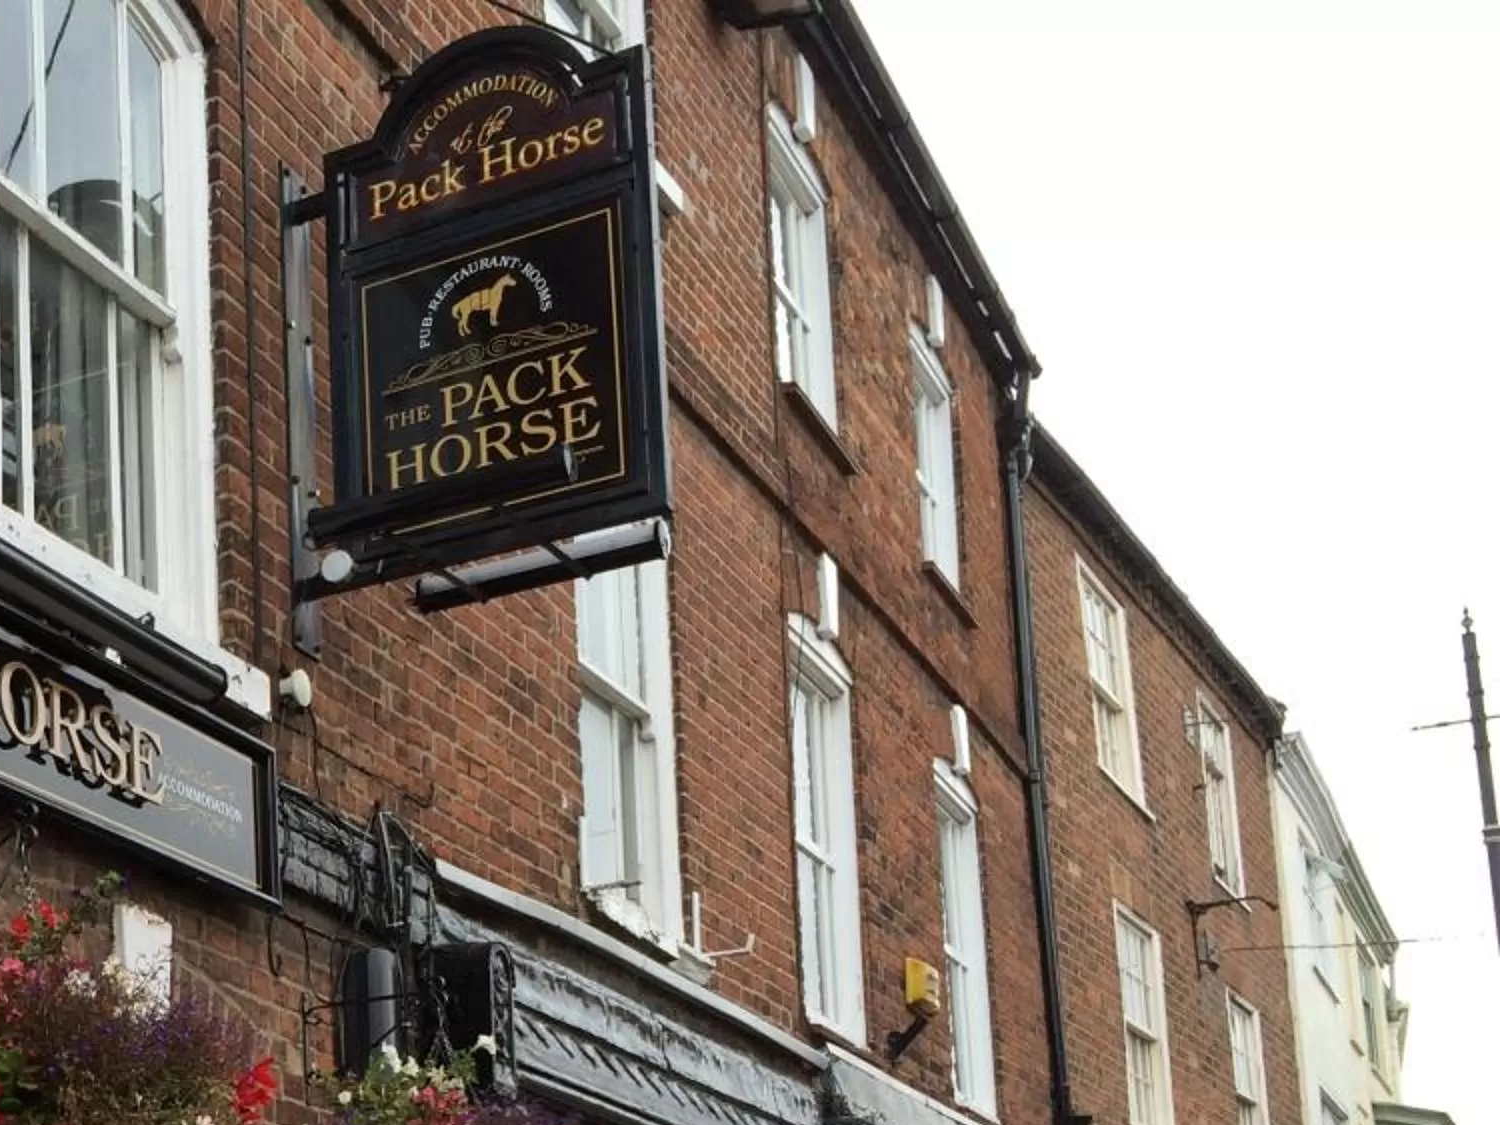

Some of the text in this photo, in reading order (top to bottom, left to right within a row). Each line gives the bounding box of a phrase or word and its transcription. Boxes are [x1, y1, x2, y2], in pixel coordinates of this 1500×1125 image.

[408, 74, 560, 156] ACCOMMODATION
[369, 113, 605, 224] Pack Horse
[385, 346, 592, 432] THE PACK
[385, 396, 602, 492] HORSE
